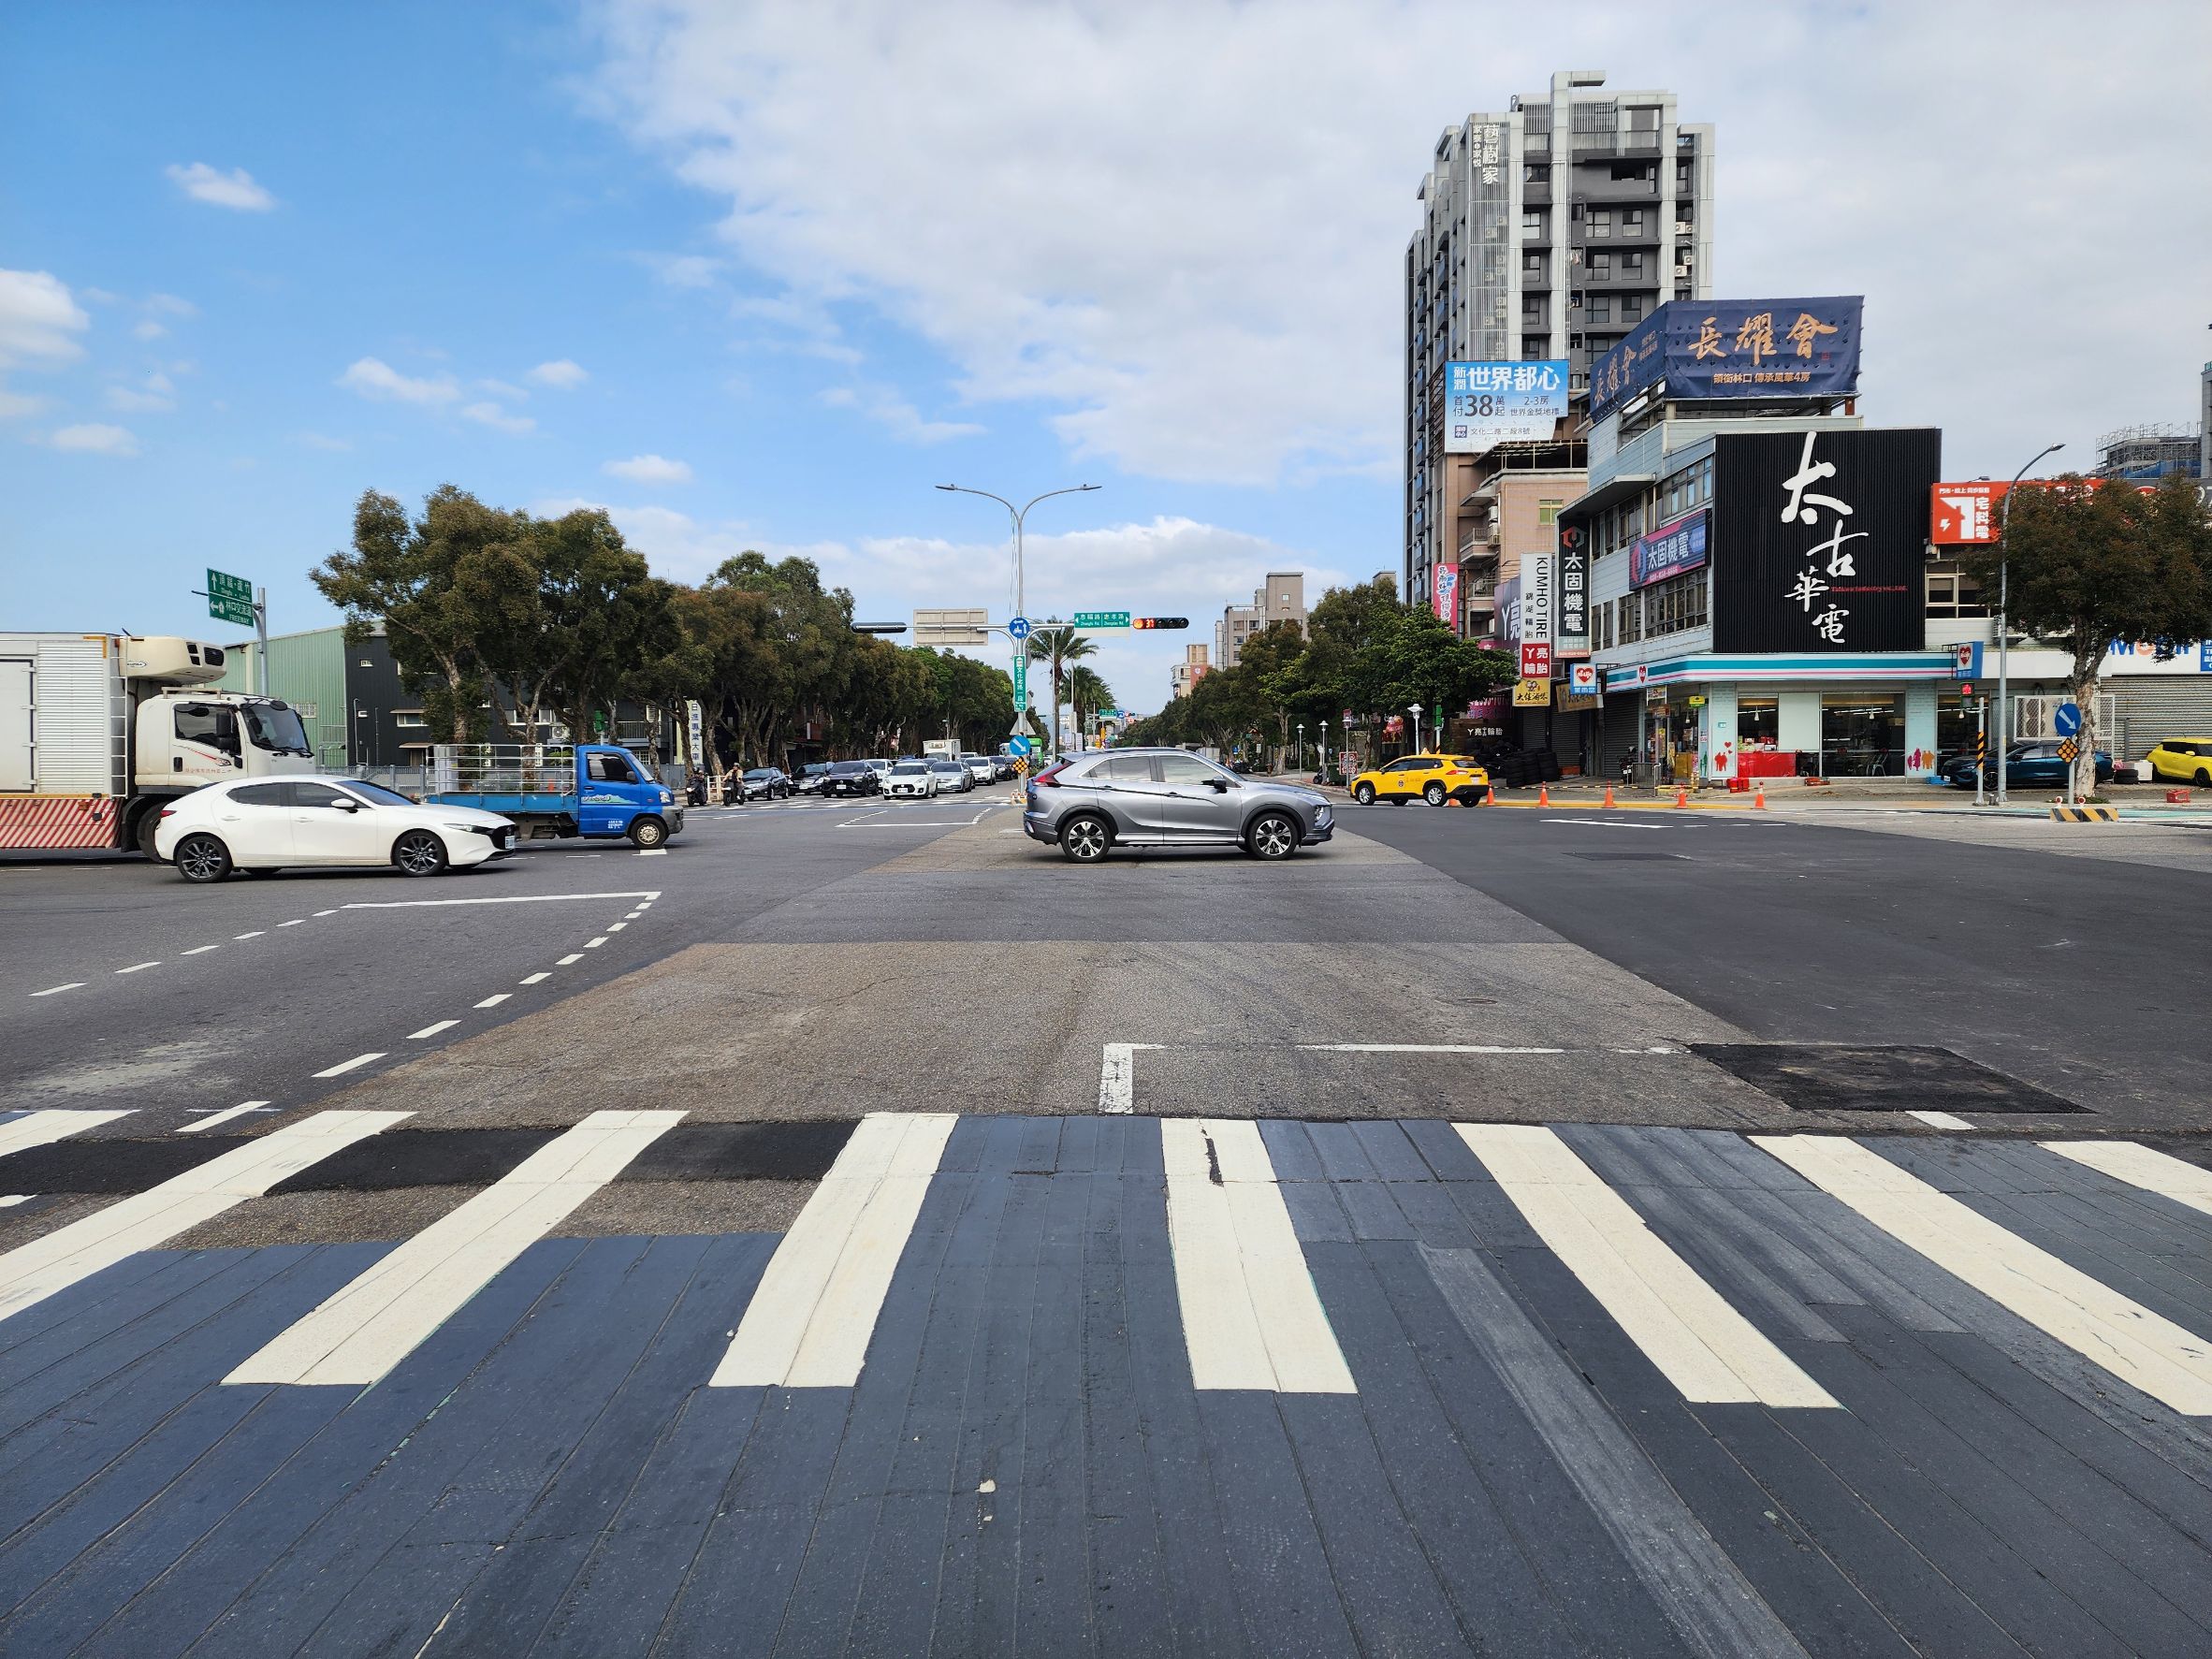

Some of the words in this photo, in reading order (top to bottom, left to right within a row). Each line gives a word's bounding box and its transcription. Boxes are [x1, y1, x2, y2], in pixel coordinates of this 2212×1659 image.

[1688, 312, 1839, 366] 長耀會
[1466, 366, 1561, 391] 世界都心
[1464, 394, 1493, 417] 38
[1524, 396, 1550, 405] 2-3房
[1648, 531, 1689, 571] 太固機電
[1536, 557, 1548, 607] KUMHO
[1564, 552, 1583, 632] 太固機電
[1535, 610, 1547, 638] TIRE
[1524, 663, 1548, 674] 輪胎
